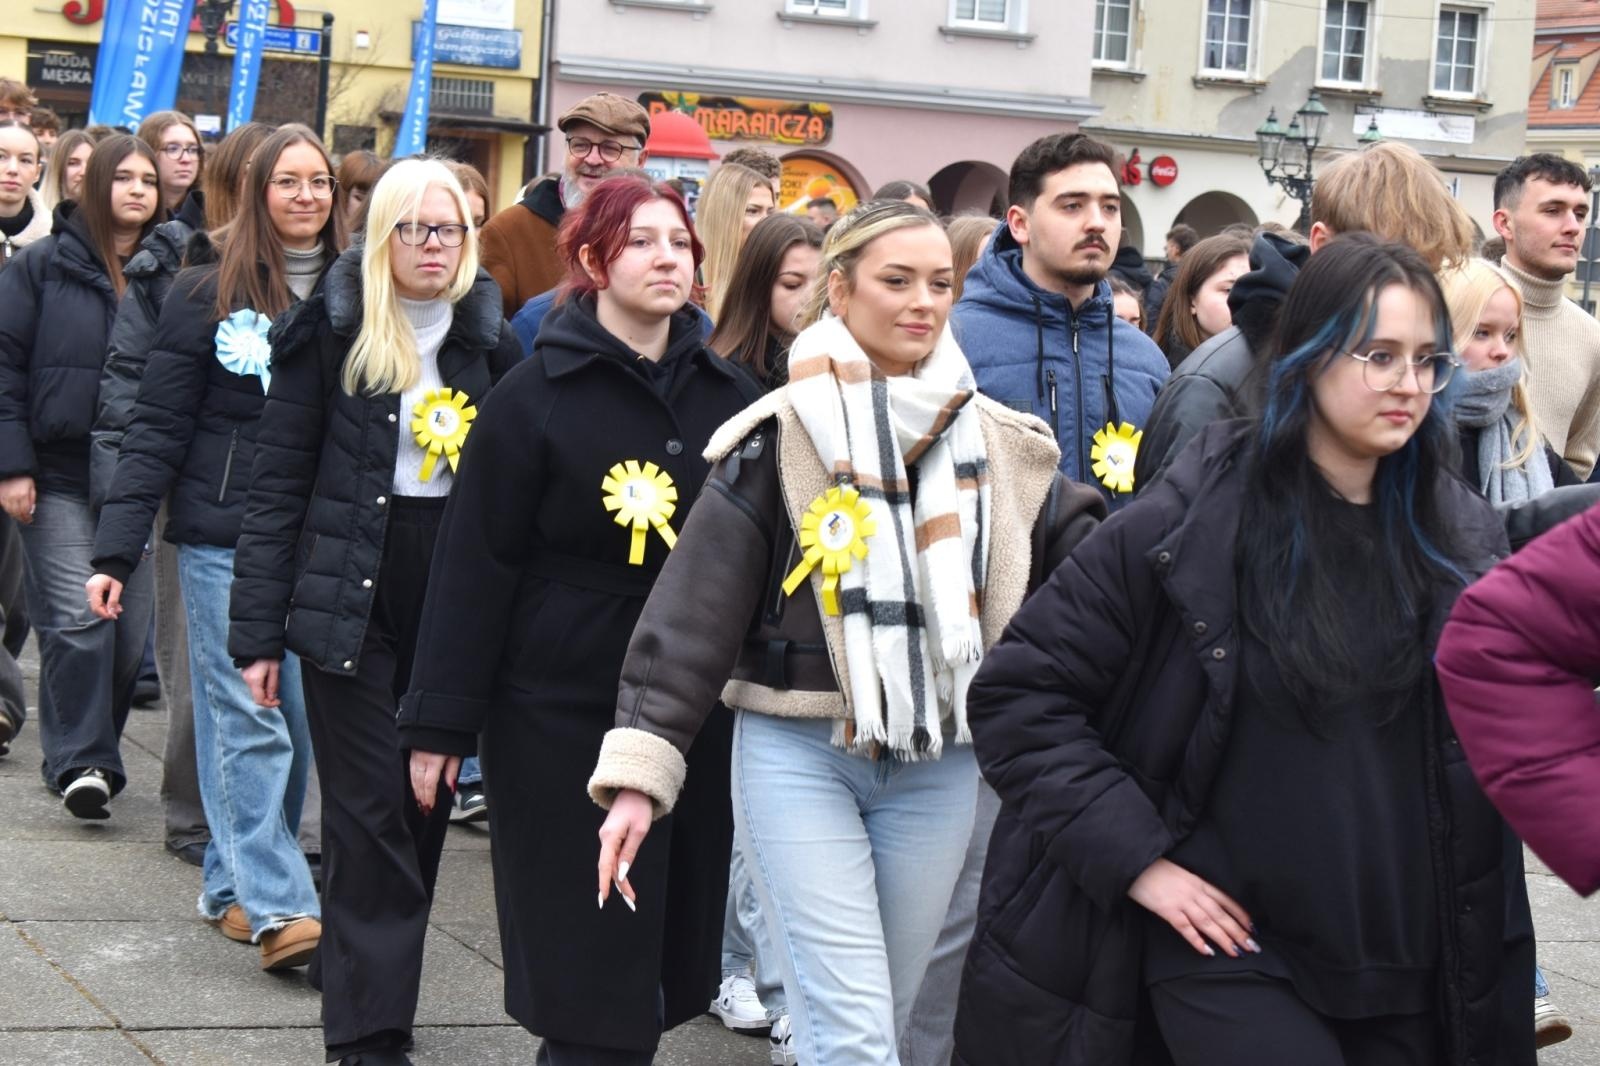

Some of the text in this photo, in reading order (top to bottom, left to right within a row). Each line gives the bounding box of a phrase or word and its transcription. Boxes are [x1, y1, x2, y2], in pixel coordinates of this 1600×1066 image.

[44, 54, 91, 68] MODA
[42, 68, 92, 85] MĘSKA
[650, 101, 825, 140] PMARAŃCZA
